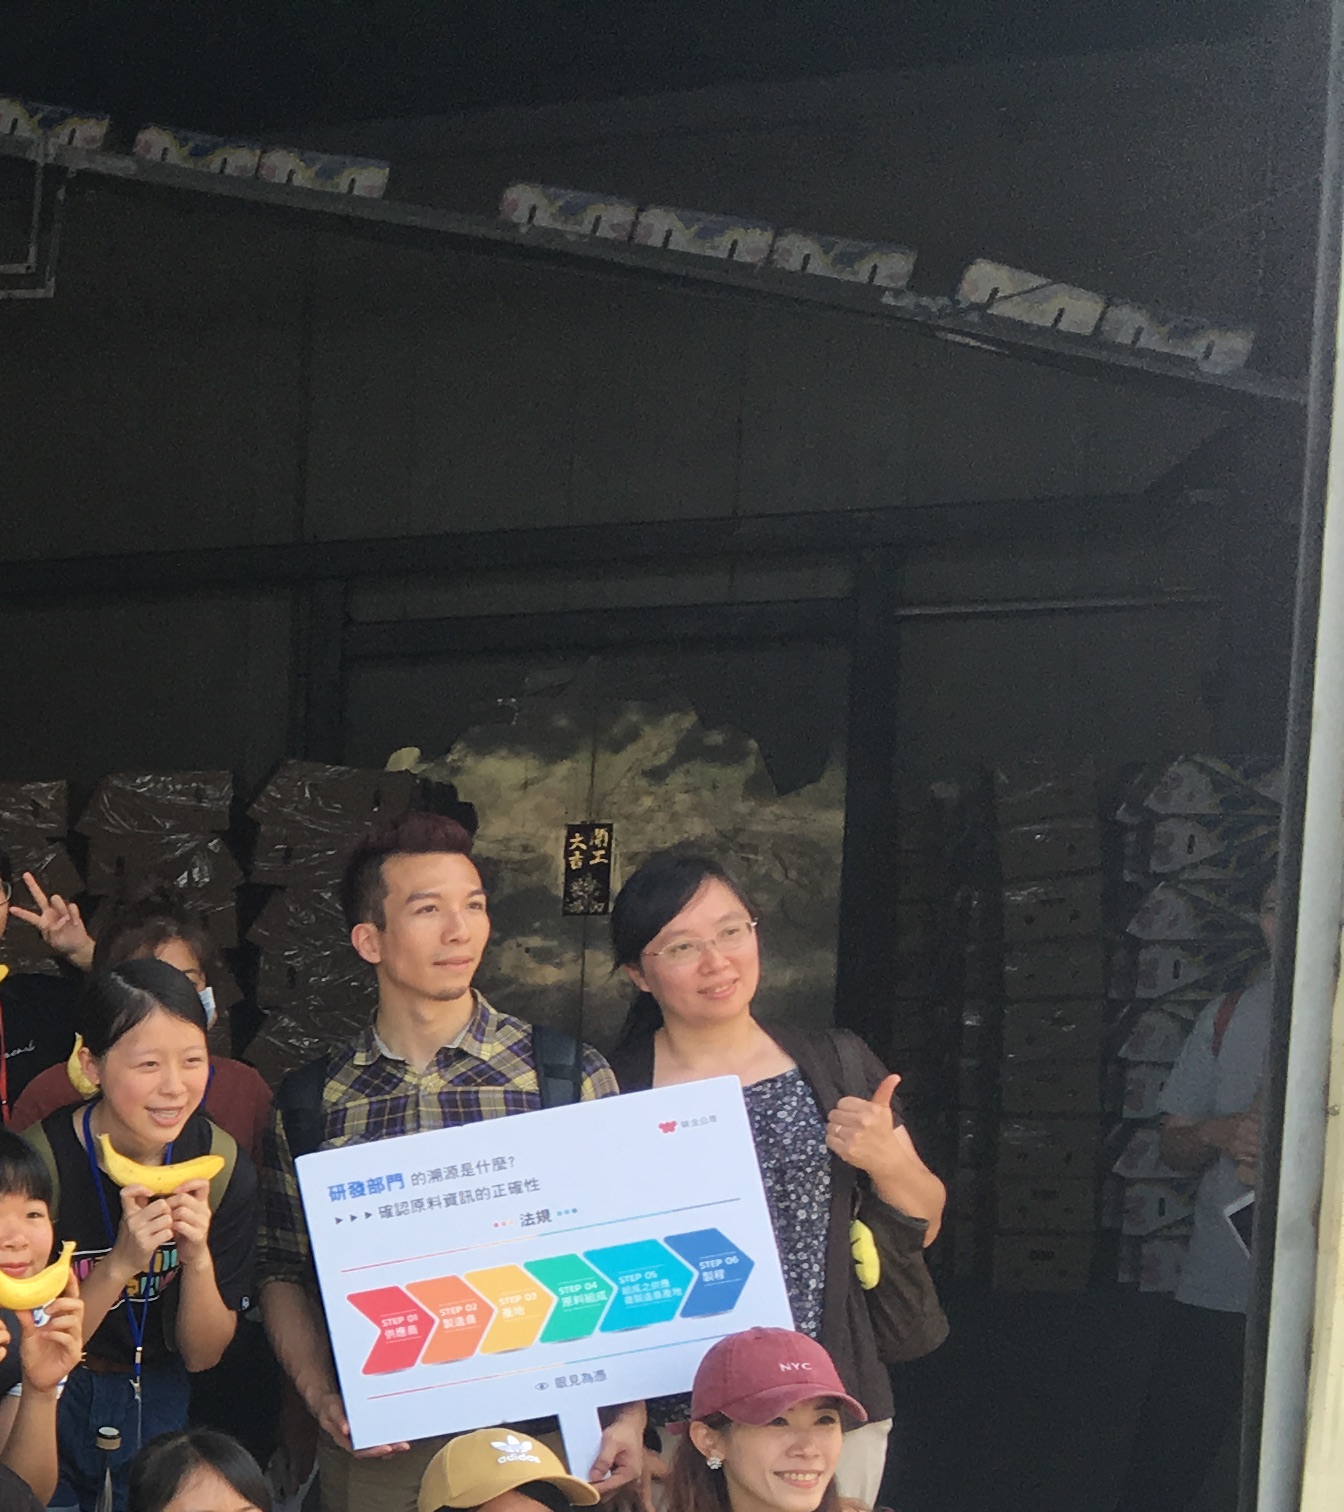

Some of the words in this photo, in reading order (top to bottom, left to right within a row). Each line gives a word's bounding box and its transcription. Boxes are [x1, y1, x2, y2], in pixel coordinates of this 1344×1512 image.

[568, 832, 587, 870] 大吉
[328, 1173, 405, 1202] 研發部門
[378, 1177, 541, 1220] 確認原料資訊的正確性
[519, 1208, 553, 1227] 法規
[699, 1258, 723, 1270] STEP
[724, 1256, 739, 1265] 06
[618, 1273, 642, 1284] STEP
[558, 1284, 582, 1295] STEP
[584, 1281, 598, 1291] 04
[498, 1294, 522, 1305] STEP
[524, 1292, 537, 1301] 03
[561, 1290, 608, 1307] 原料組成
[439, 1305, 463, 1316] STEP
[464, 1303, 478, 1312] 02
[502, 1306, 525, 1318] 產地
[381, 1316, 405, 1327] STEP
[406, 1314, 418, 1323] 01
[442, 1314, 477, 1329] 製造商
[384, 1325, 418, 1340] 供應商
[778, 1362, 813, 1372] NYC
[497, 1453, 542, 1464] adidas
